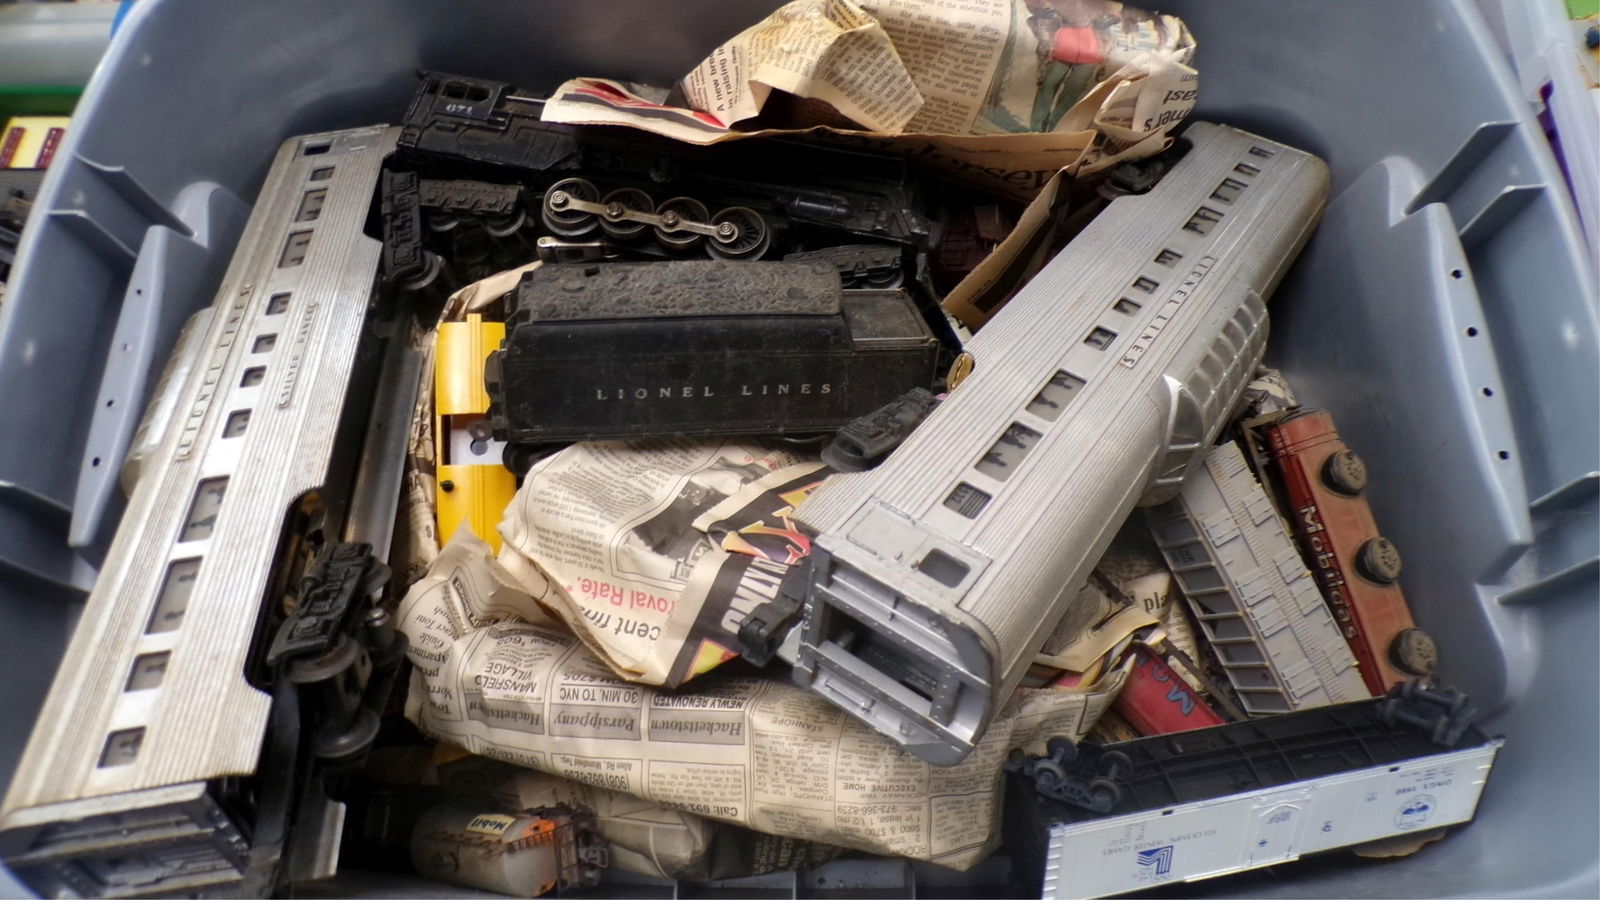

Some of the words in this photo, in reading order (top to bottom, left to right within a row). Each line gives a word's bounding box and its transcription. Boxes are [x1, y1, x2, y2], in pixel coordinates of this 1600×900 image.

[719, 57, 733, 95] raising
[712, 79, 723, 101] new
[716, 103, 725, 112] A
[1167, 254, 1216, 306] LIONEL
[1121, 314, 1169, 365] LINES
[178, 366, 221, 455] LIONEL
[219, 289, 252, 349] LINES
[597, 385, 715, 401] LIONEL
[741, 383, 833, 396] LINES
[1299, 505, 1360, 640] Mobilgas
[614, 617, 661, 641] cent
[419, 632, 445, 649] Guide
[484, 662, 534, 681] VILLAGE
[474, 675, 538, 694] MANSFIELD
[559, 687, 580, 701] NYC
[582, 688, 597, 702] TO
[623, 690, 639, 704] 30
[653, 694, 710, 709] RENOVATED
[709, 697, 743, 710] NEWLY
[553, 711, 636, 732] Parsippany
[650, 720, 743, 738] Hackettstown
[770, 717, 826, 733] STANHOPE
[842, 782, 866, 791] HOME
[871, 784, 917, 792] EXECUTIVE
[713, 805, 738, 817] Call:
[470, 817, 509, 832] Mobil
